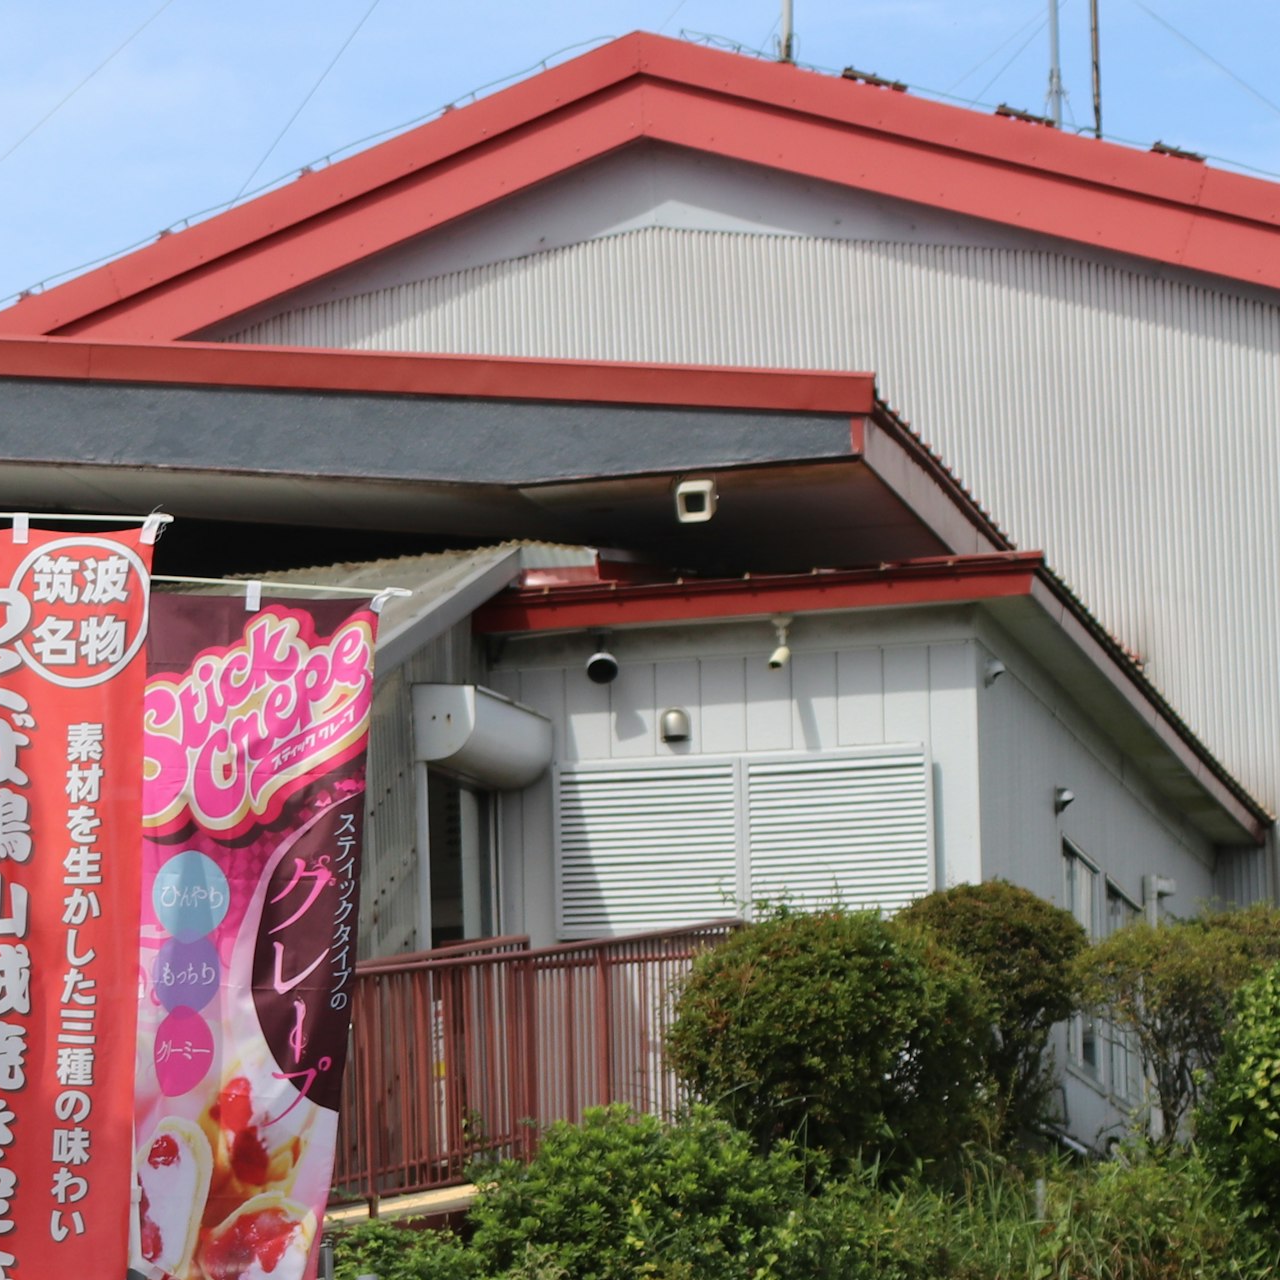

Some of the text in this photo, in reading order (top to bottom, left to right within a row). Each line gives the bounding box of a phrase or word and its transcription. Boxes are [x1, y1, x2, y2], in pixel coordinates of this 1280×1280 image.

[32, 555, 131, 605] 筑波
[32, 615, 127, 667] 名物
[142, 618, 300, 820] Stick
[192, 625, 371, 820] Crepe
[160, 884, 226, 912] ひんやり
[328, 813, 357, 1011] スティックタイプの
[50, 722, 105, 1243] 素材を生かした三種の味わい
[161, 963, 216, 988] もっちり
[156, 1039, 211, 1064] クリーミー
